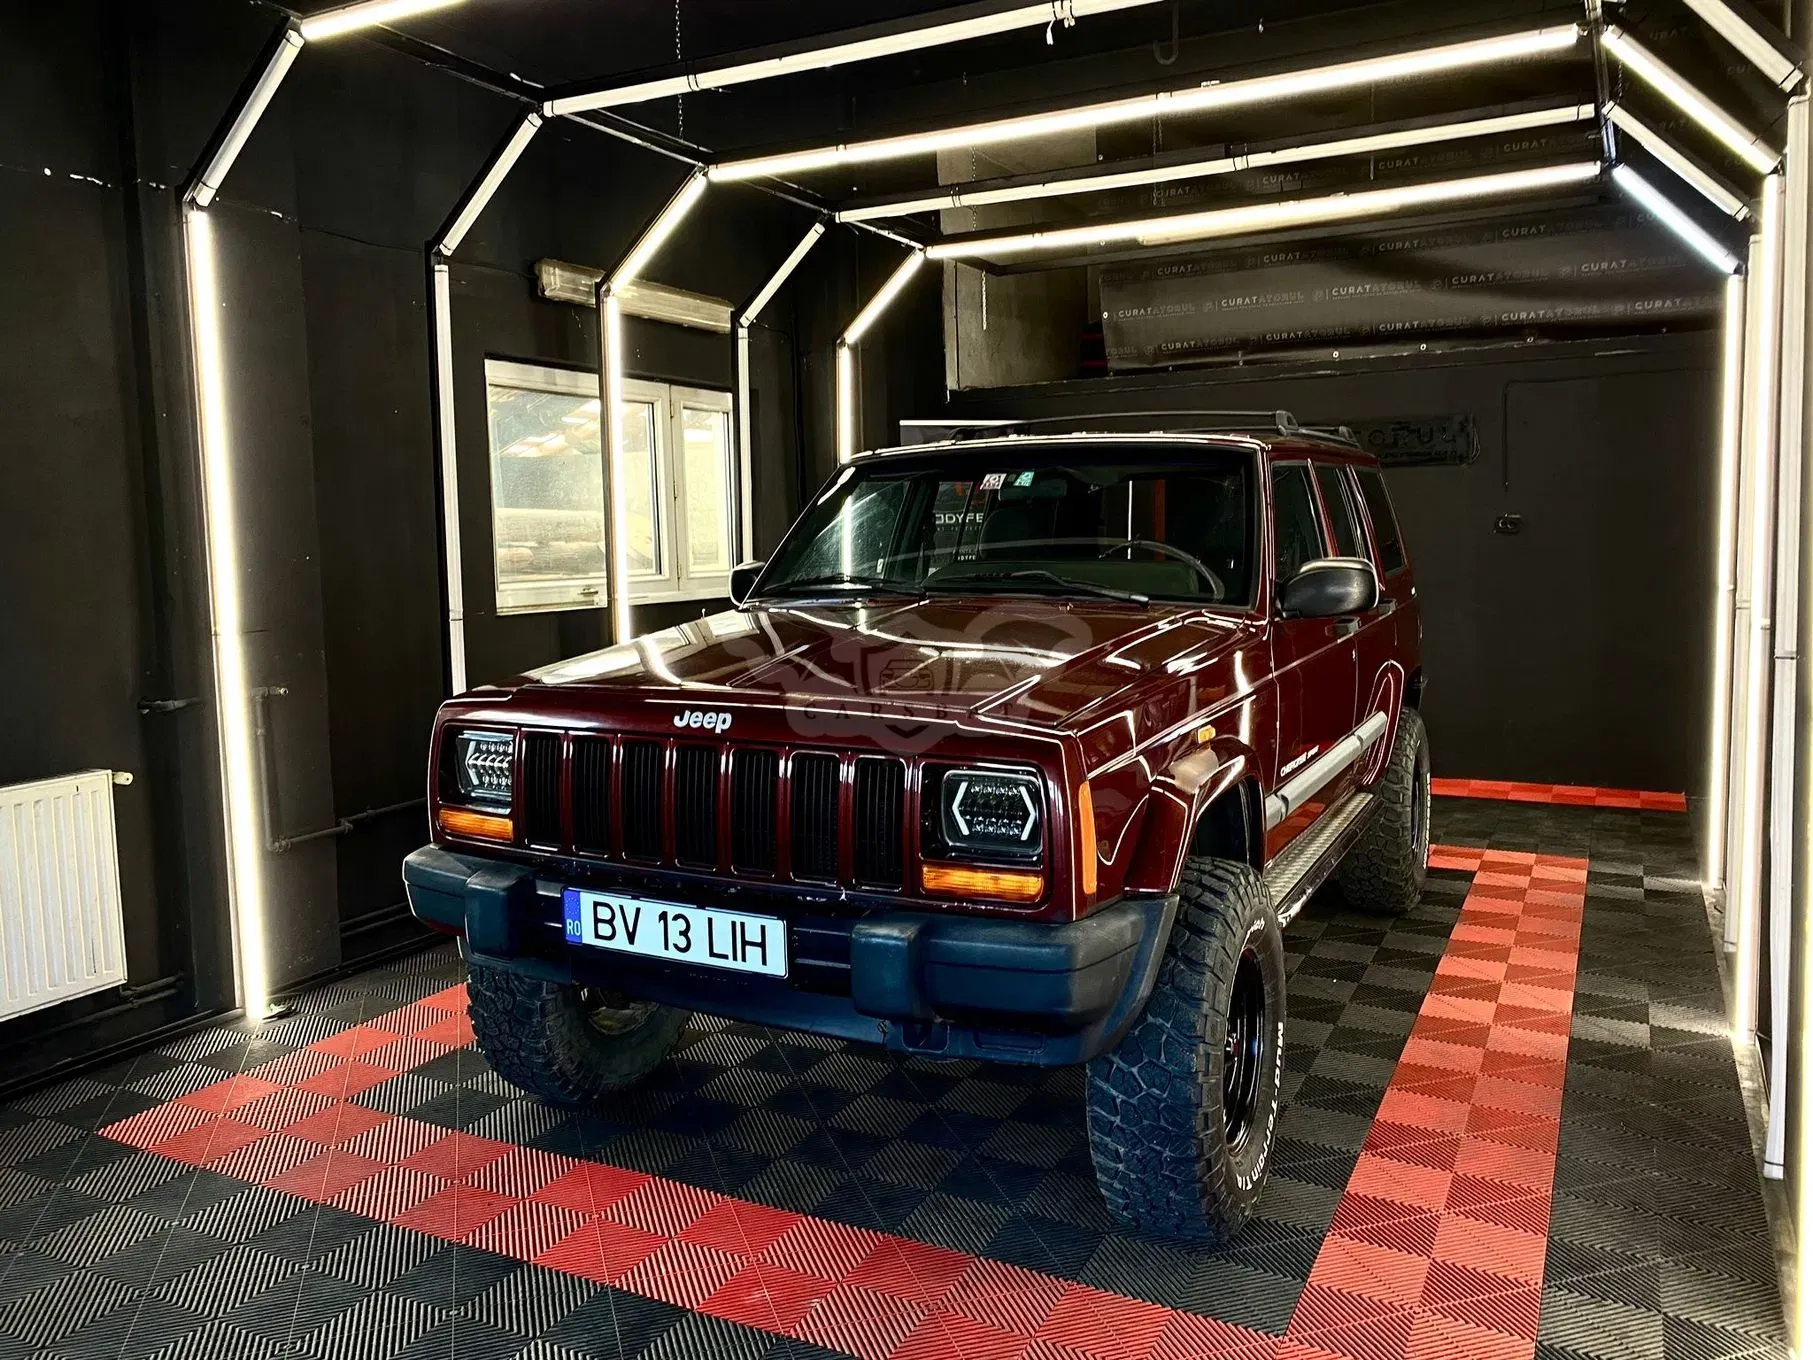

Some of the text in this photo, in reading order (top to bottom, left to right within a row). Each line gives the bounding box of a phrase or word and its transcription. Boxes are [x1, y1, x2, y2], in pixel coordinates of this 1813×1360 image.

[673, 709, 733, 734] Jeep
[566, 919, 581, 937] RO
[592, 900, 768, 967] BV 13 LIH
